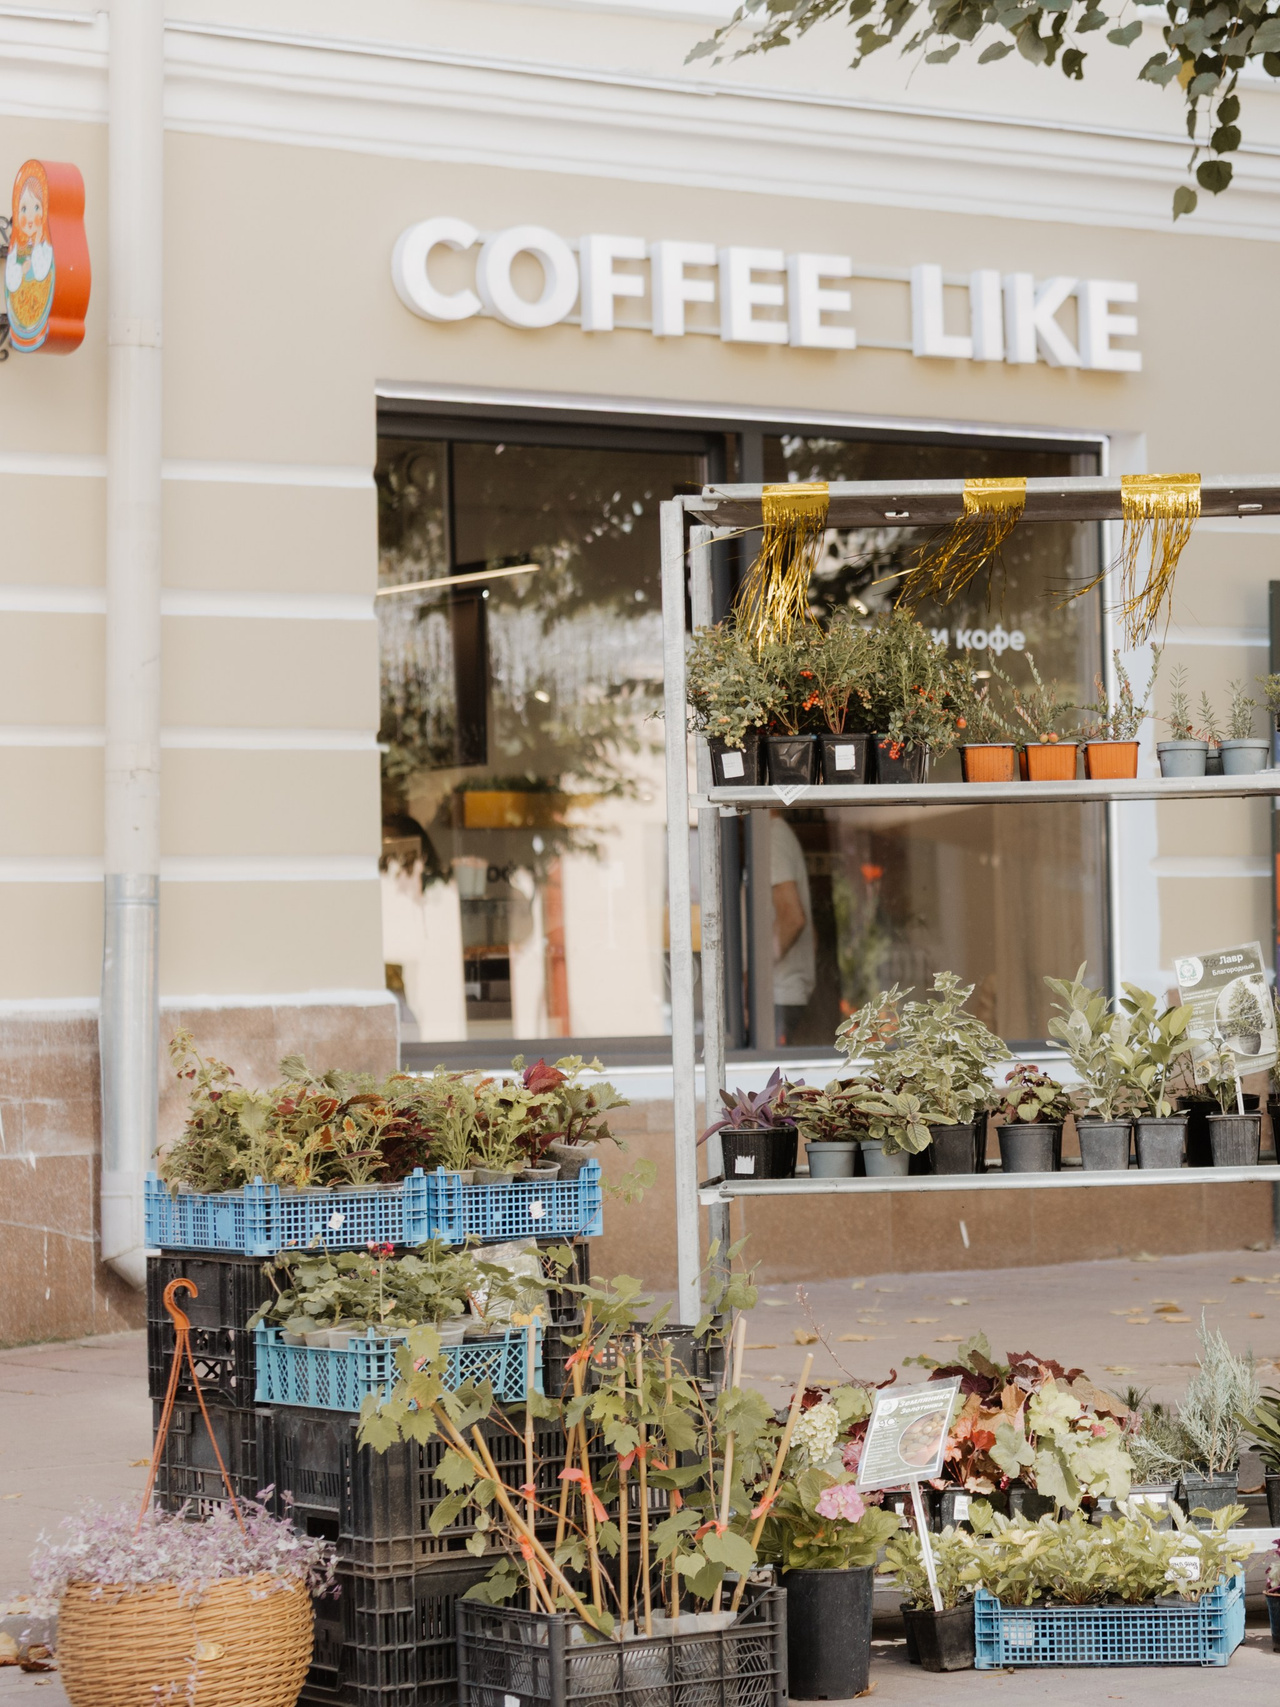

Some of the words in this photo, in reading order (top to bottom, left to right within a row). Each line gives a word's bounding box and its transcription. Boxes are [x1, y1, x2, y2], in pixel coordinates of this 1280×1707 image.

[391, 216, 857, 350] COFFEE
[911, 263, 1143, 373] LIKE
[955, 623, 1026, 657] кофе
[1219, 954, 1244, 965] Лавр
[1211, 962, 1255, 976] Благородный
[898, 1393, 951, 1408] Земляника
